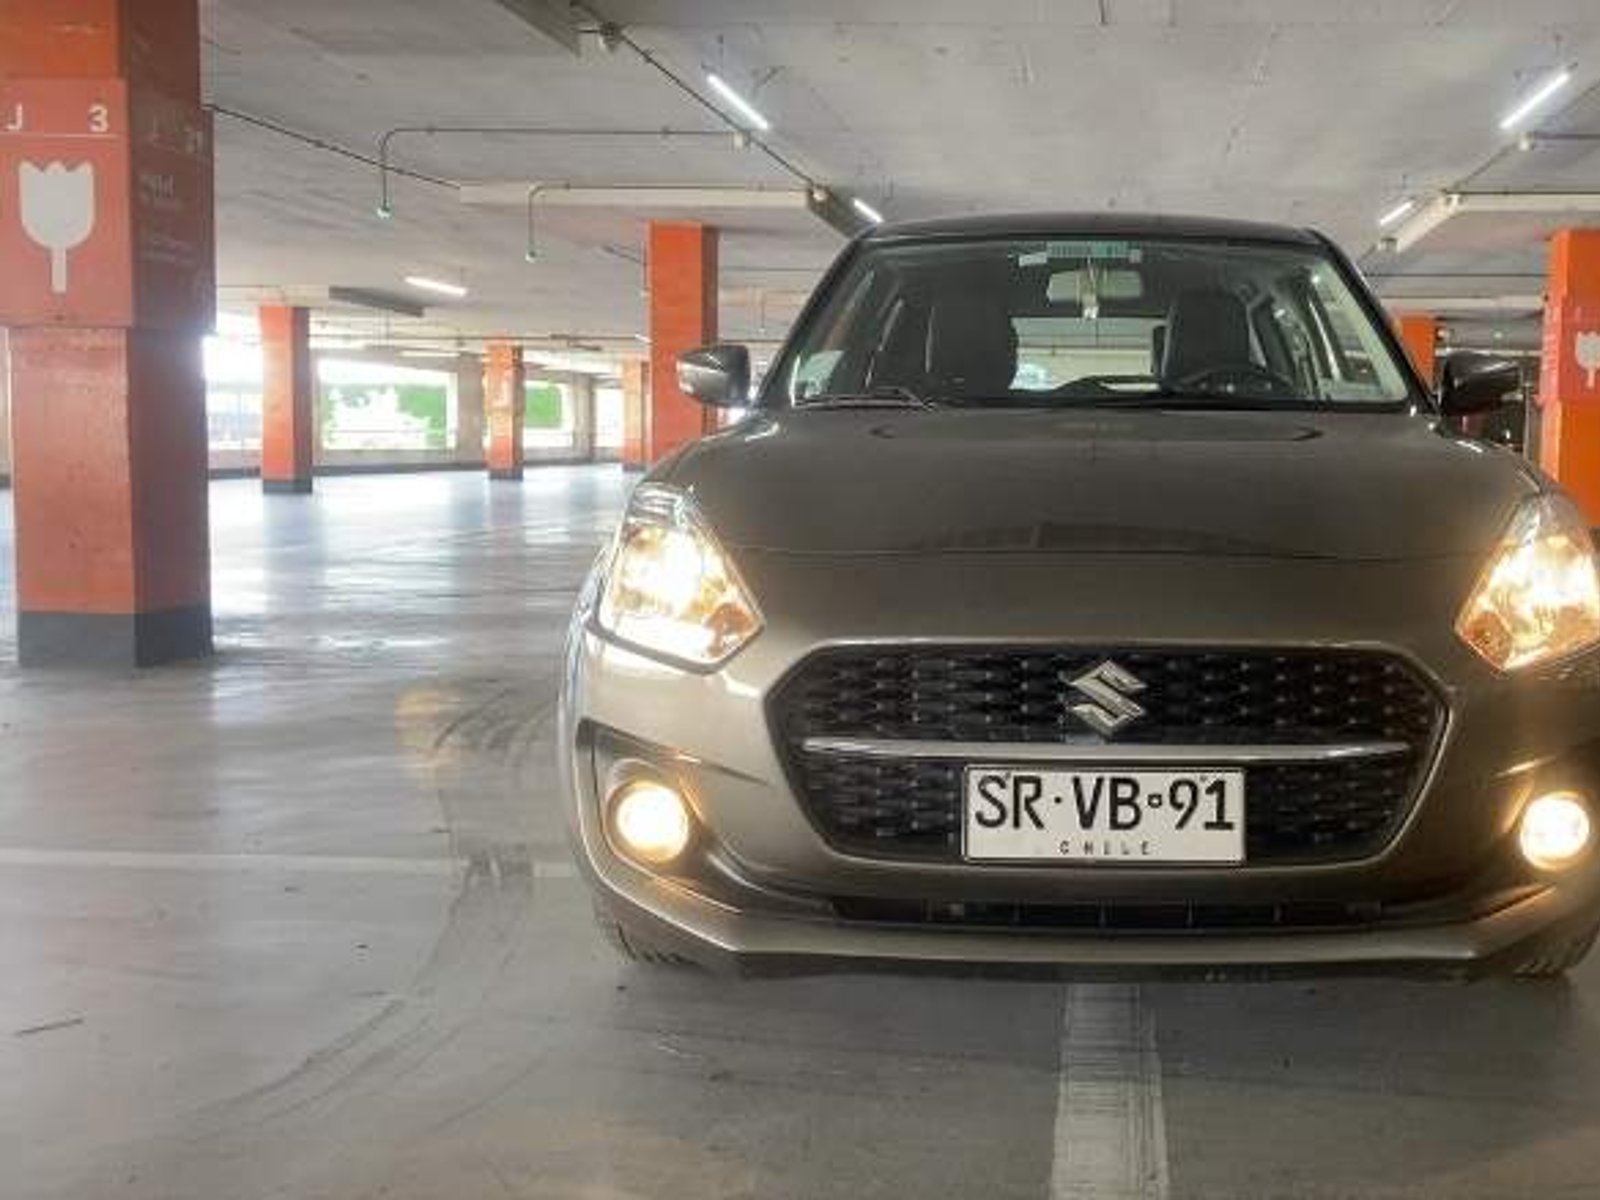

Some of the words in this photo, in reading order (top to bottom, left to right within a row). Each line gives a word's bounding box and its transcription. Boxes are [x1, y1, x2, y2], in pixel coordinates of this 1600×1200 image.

[6, 103, 23, 131] J
[88, 103, 109, 132] 3
[1060, 840, 1153, 855] CHILE
